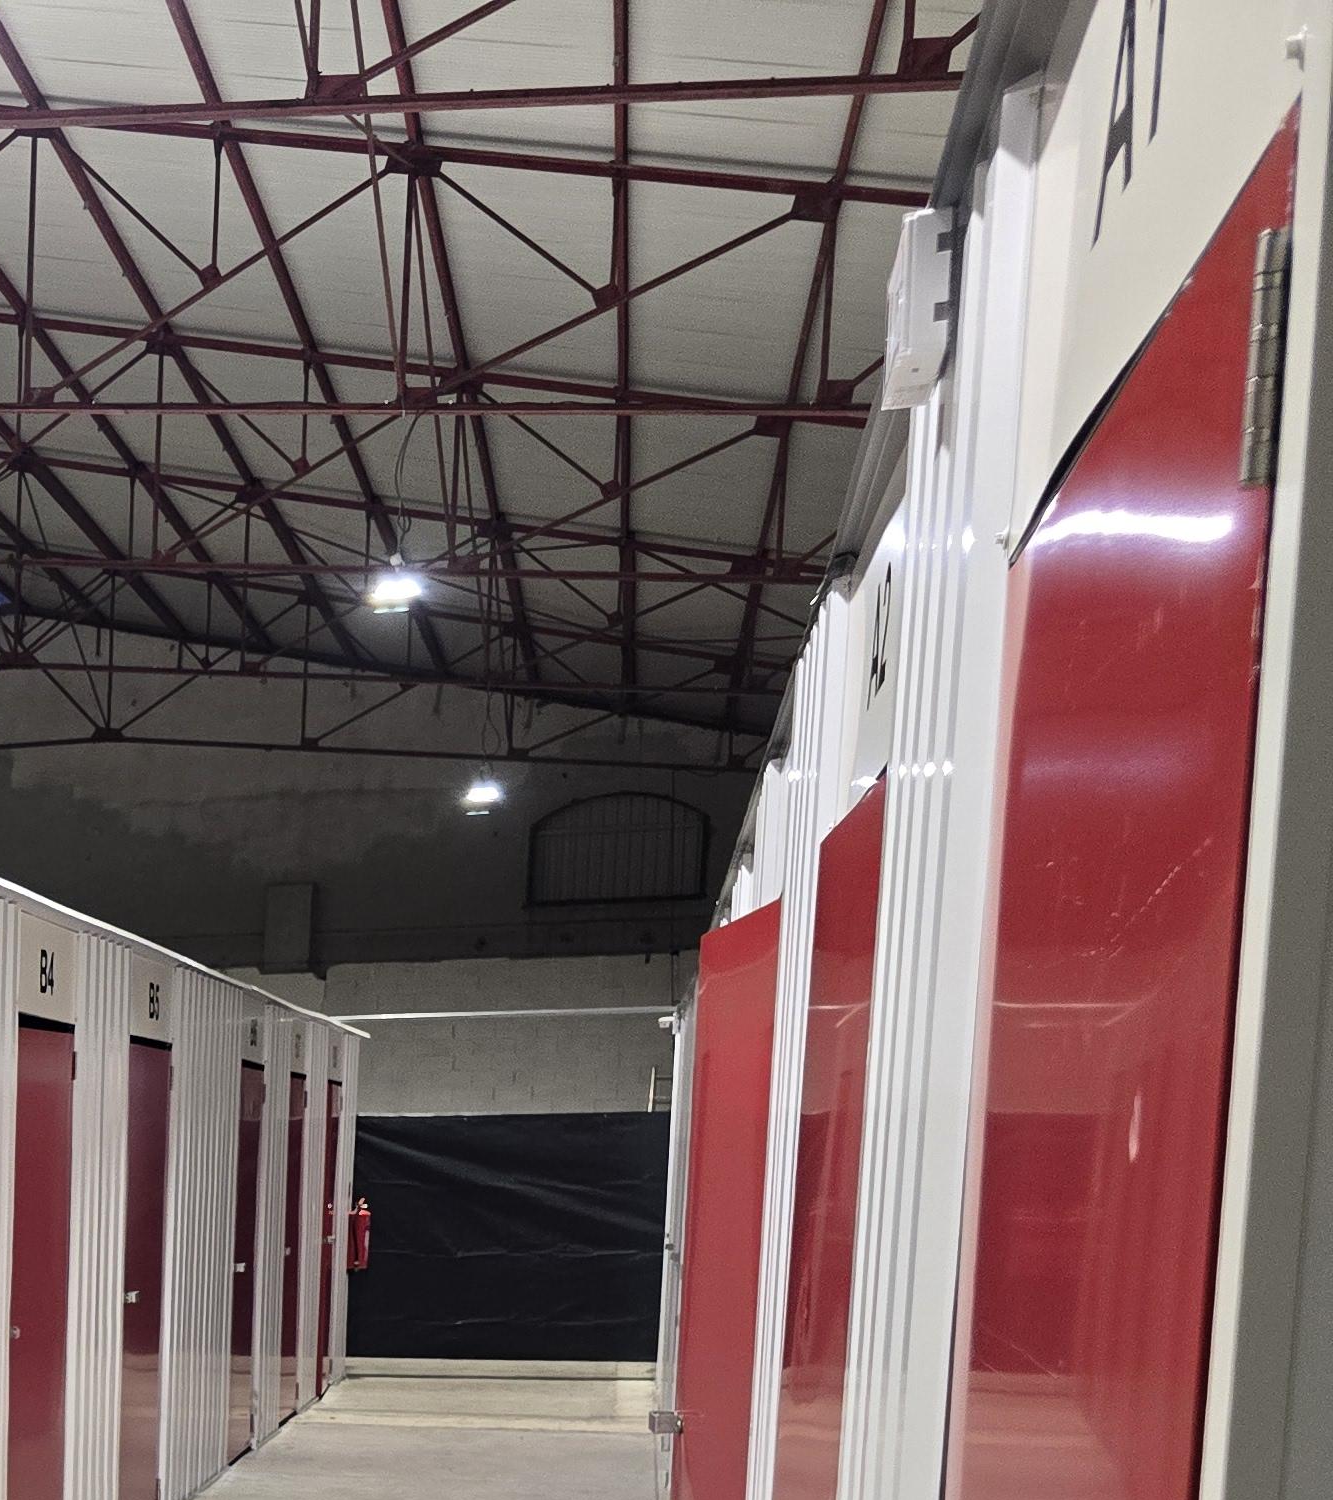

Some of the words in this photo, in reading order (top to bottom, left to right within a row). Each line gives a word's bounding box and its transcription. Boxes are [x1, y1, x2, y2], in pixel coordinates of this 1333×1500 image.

[1090, 0, 1168, 251] A1
[866, 561, 892, 711] A2
[39, 949, 55, 996] B4
[148, 982, 160, 1021] B5
